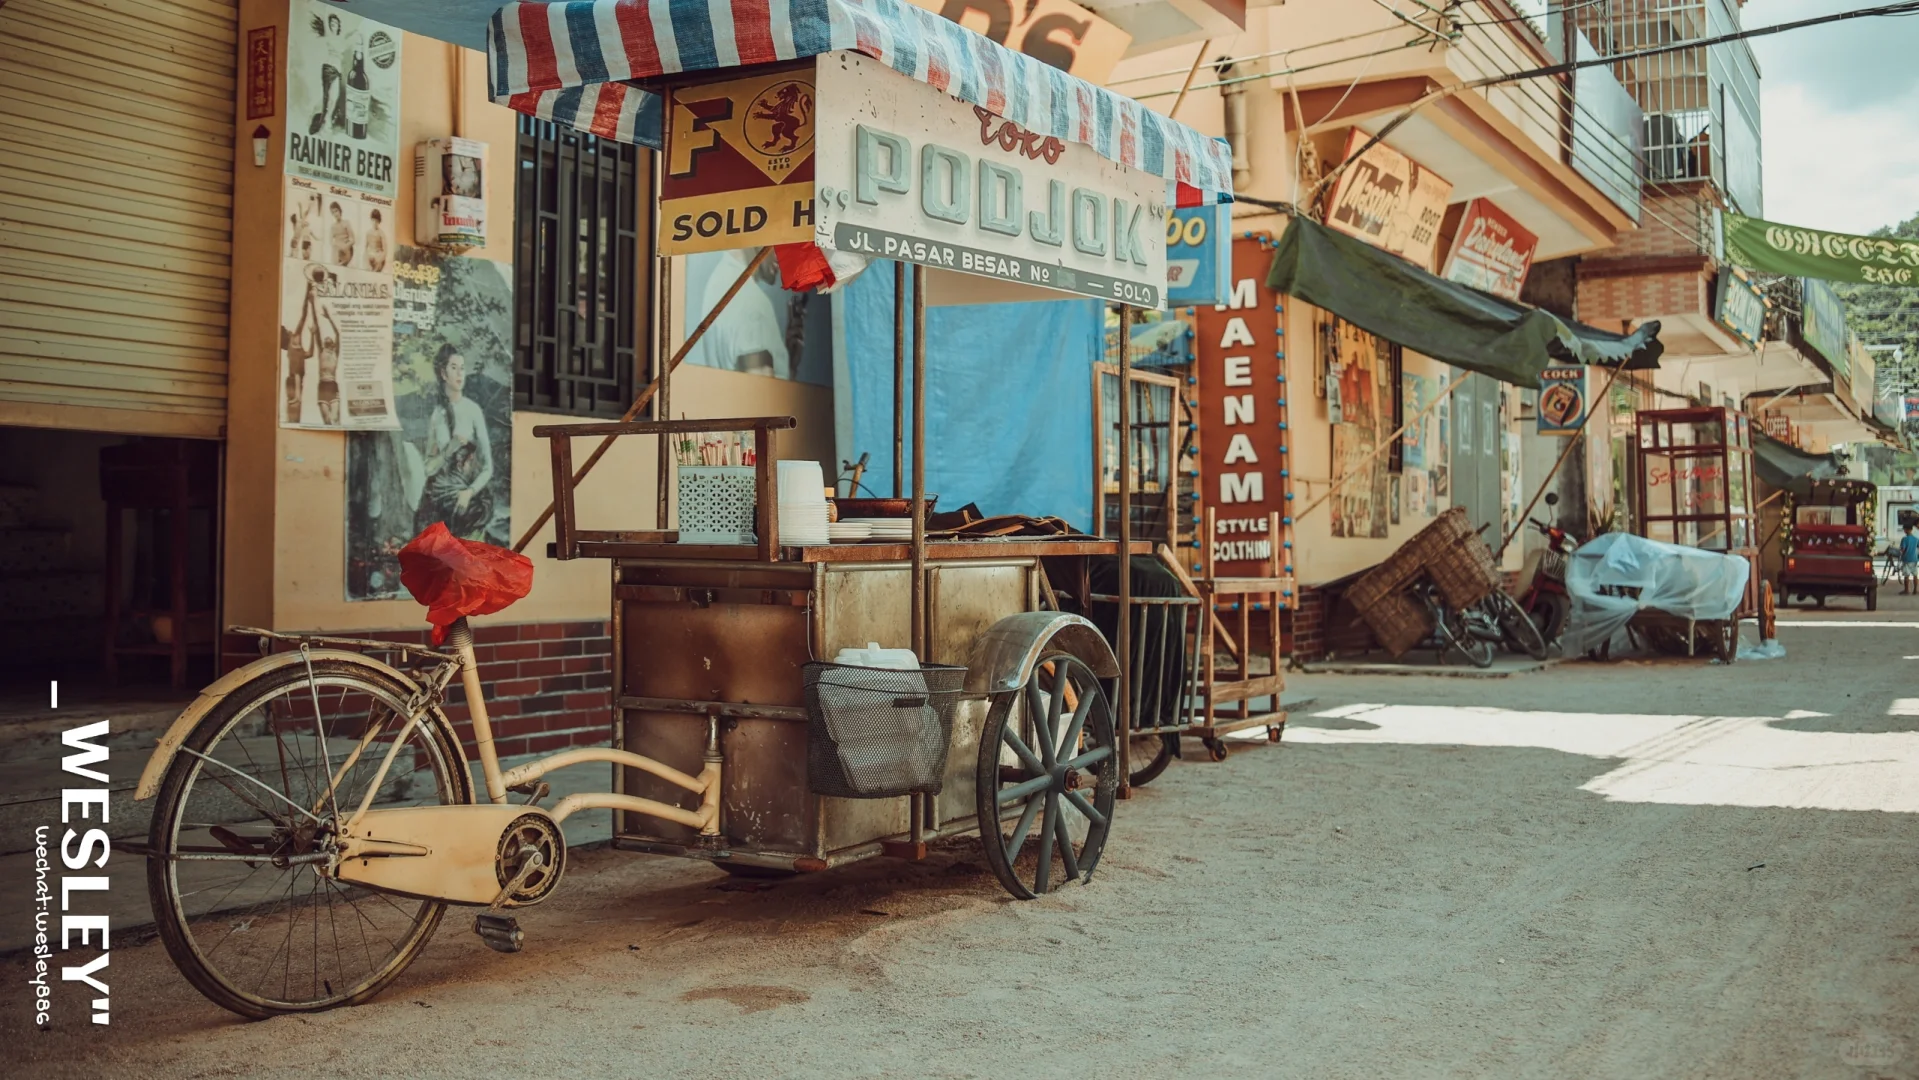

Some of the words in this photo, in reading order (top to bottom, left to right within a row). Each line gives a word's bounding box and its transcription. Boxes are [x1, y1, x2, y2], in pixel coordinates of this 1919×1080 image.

[290, 131, 351, 173] RAINIER
[357, 148, 393, 183] BEER
[672, 206, 768, 241] SOLD
[1421, 206, 1441, 229] ROOT
[1411, 224, 1432, 247] BEER
[962, 252, 1021, 278] BESAR
[1113, 281, 1152, 304] SOLO
[1543, 370, 1579, 380] COCK
[1215, 278, 1264, 503] MAENAM
[1766, 417, 1788, 437] COFFEE
[1216, 518, 1268, 534] STYLE
[1212, 540, 1270, 562] COLTHIN
